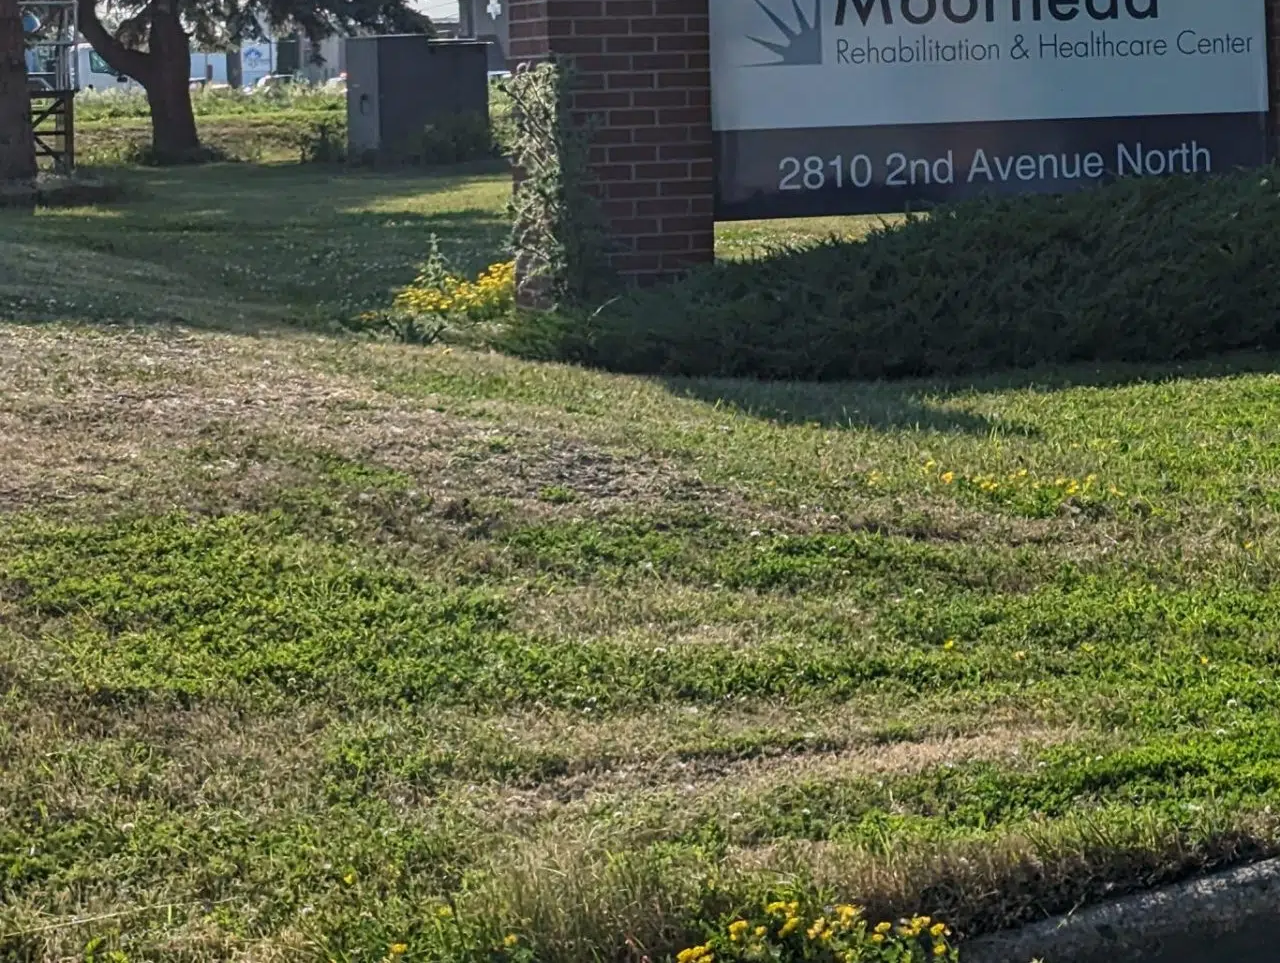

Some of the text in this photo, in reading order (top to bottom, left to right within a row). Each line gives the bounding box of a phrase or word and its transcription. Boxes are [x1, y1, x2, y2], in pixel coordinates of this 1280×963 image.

[836, 29, 1253, 65] Rehabilitation & Healthcare Center
[778, 140, 1212, 190] 2810 2nd Avenue North
